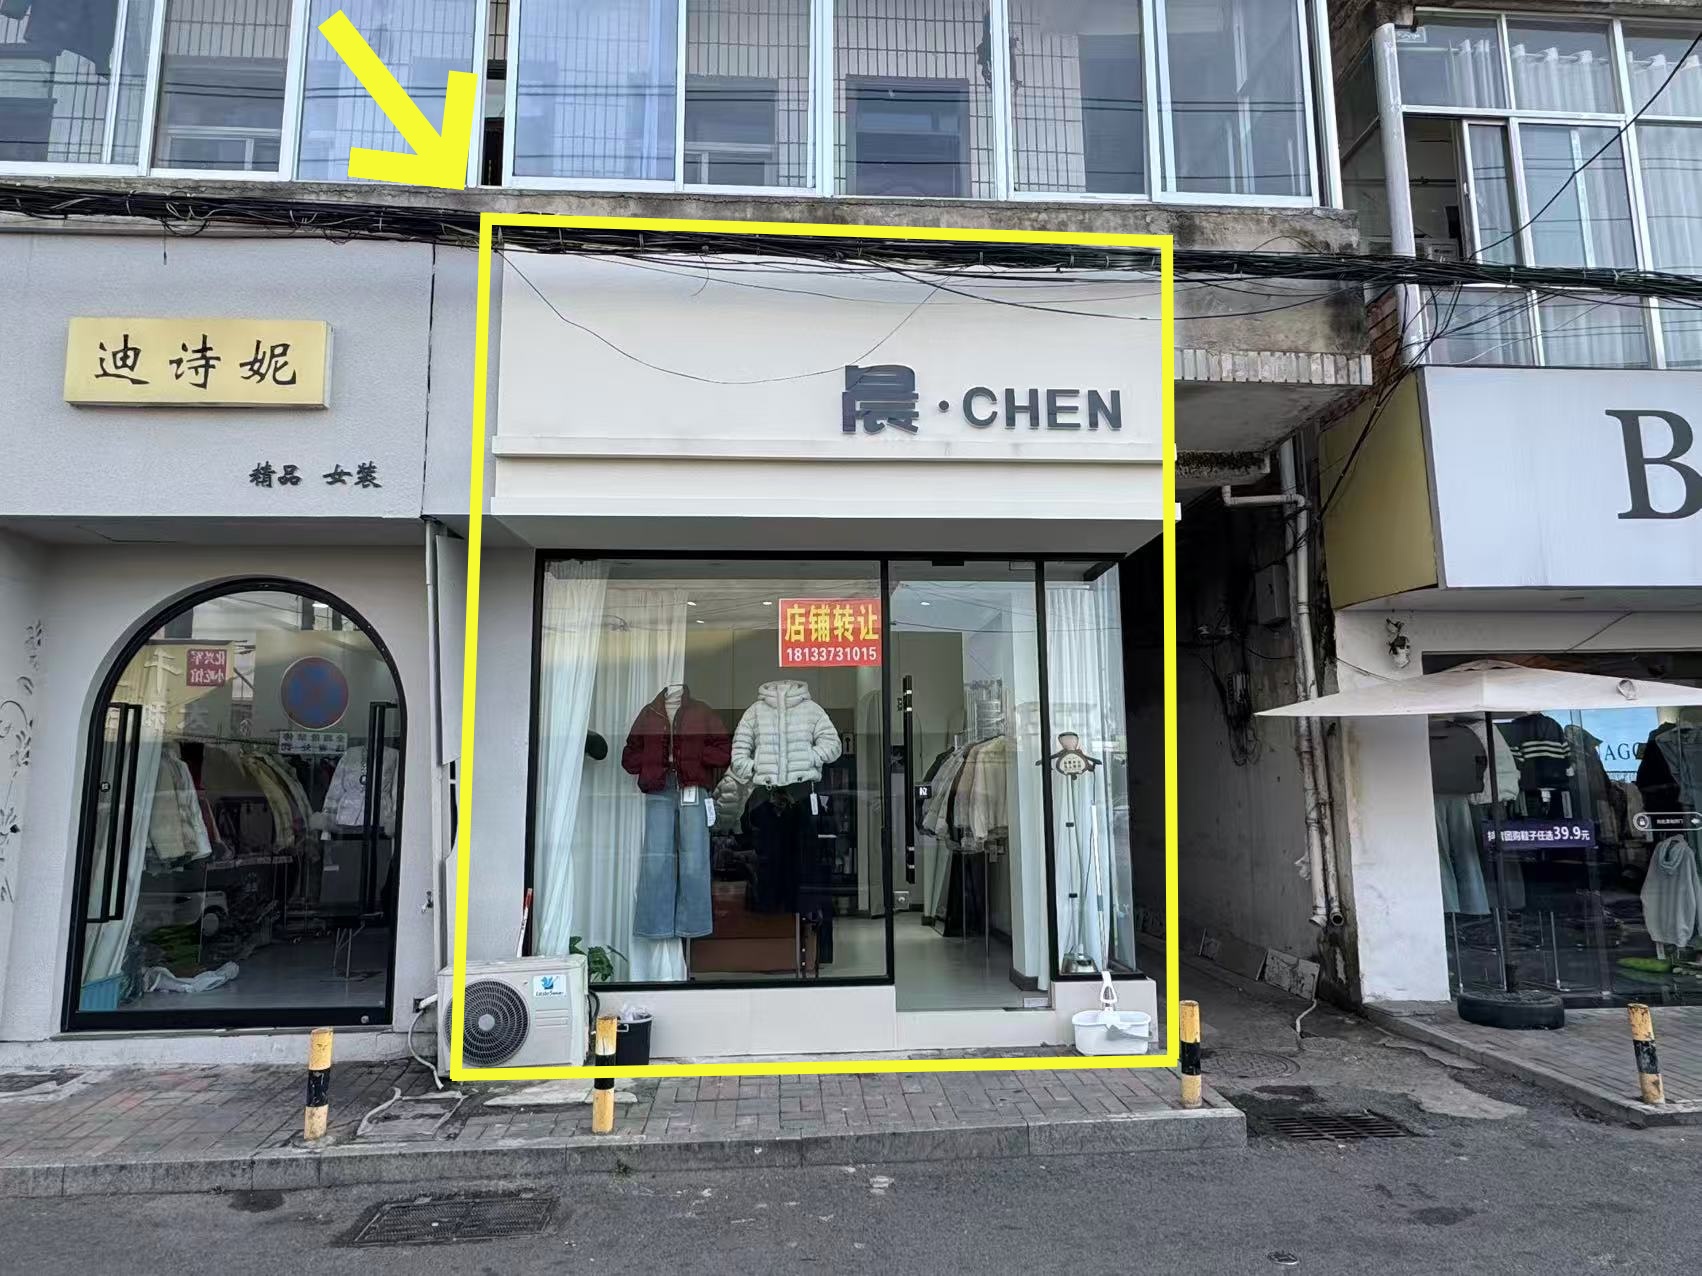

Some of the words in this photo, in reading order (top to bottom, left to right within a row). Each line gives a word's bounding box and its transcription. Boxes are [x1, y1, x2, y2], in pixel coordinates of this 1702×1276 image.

[95, 333, 297, 390] 迪诗妮
[249, 461, 303, 488] 精品
[322, 460, 383, 488] 女装
[784, 603, 880, 642] 店铺转让
[786, 646, 877, 662] 18133731015
